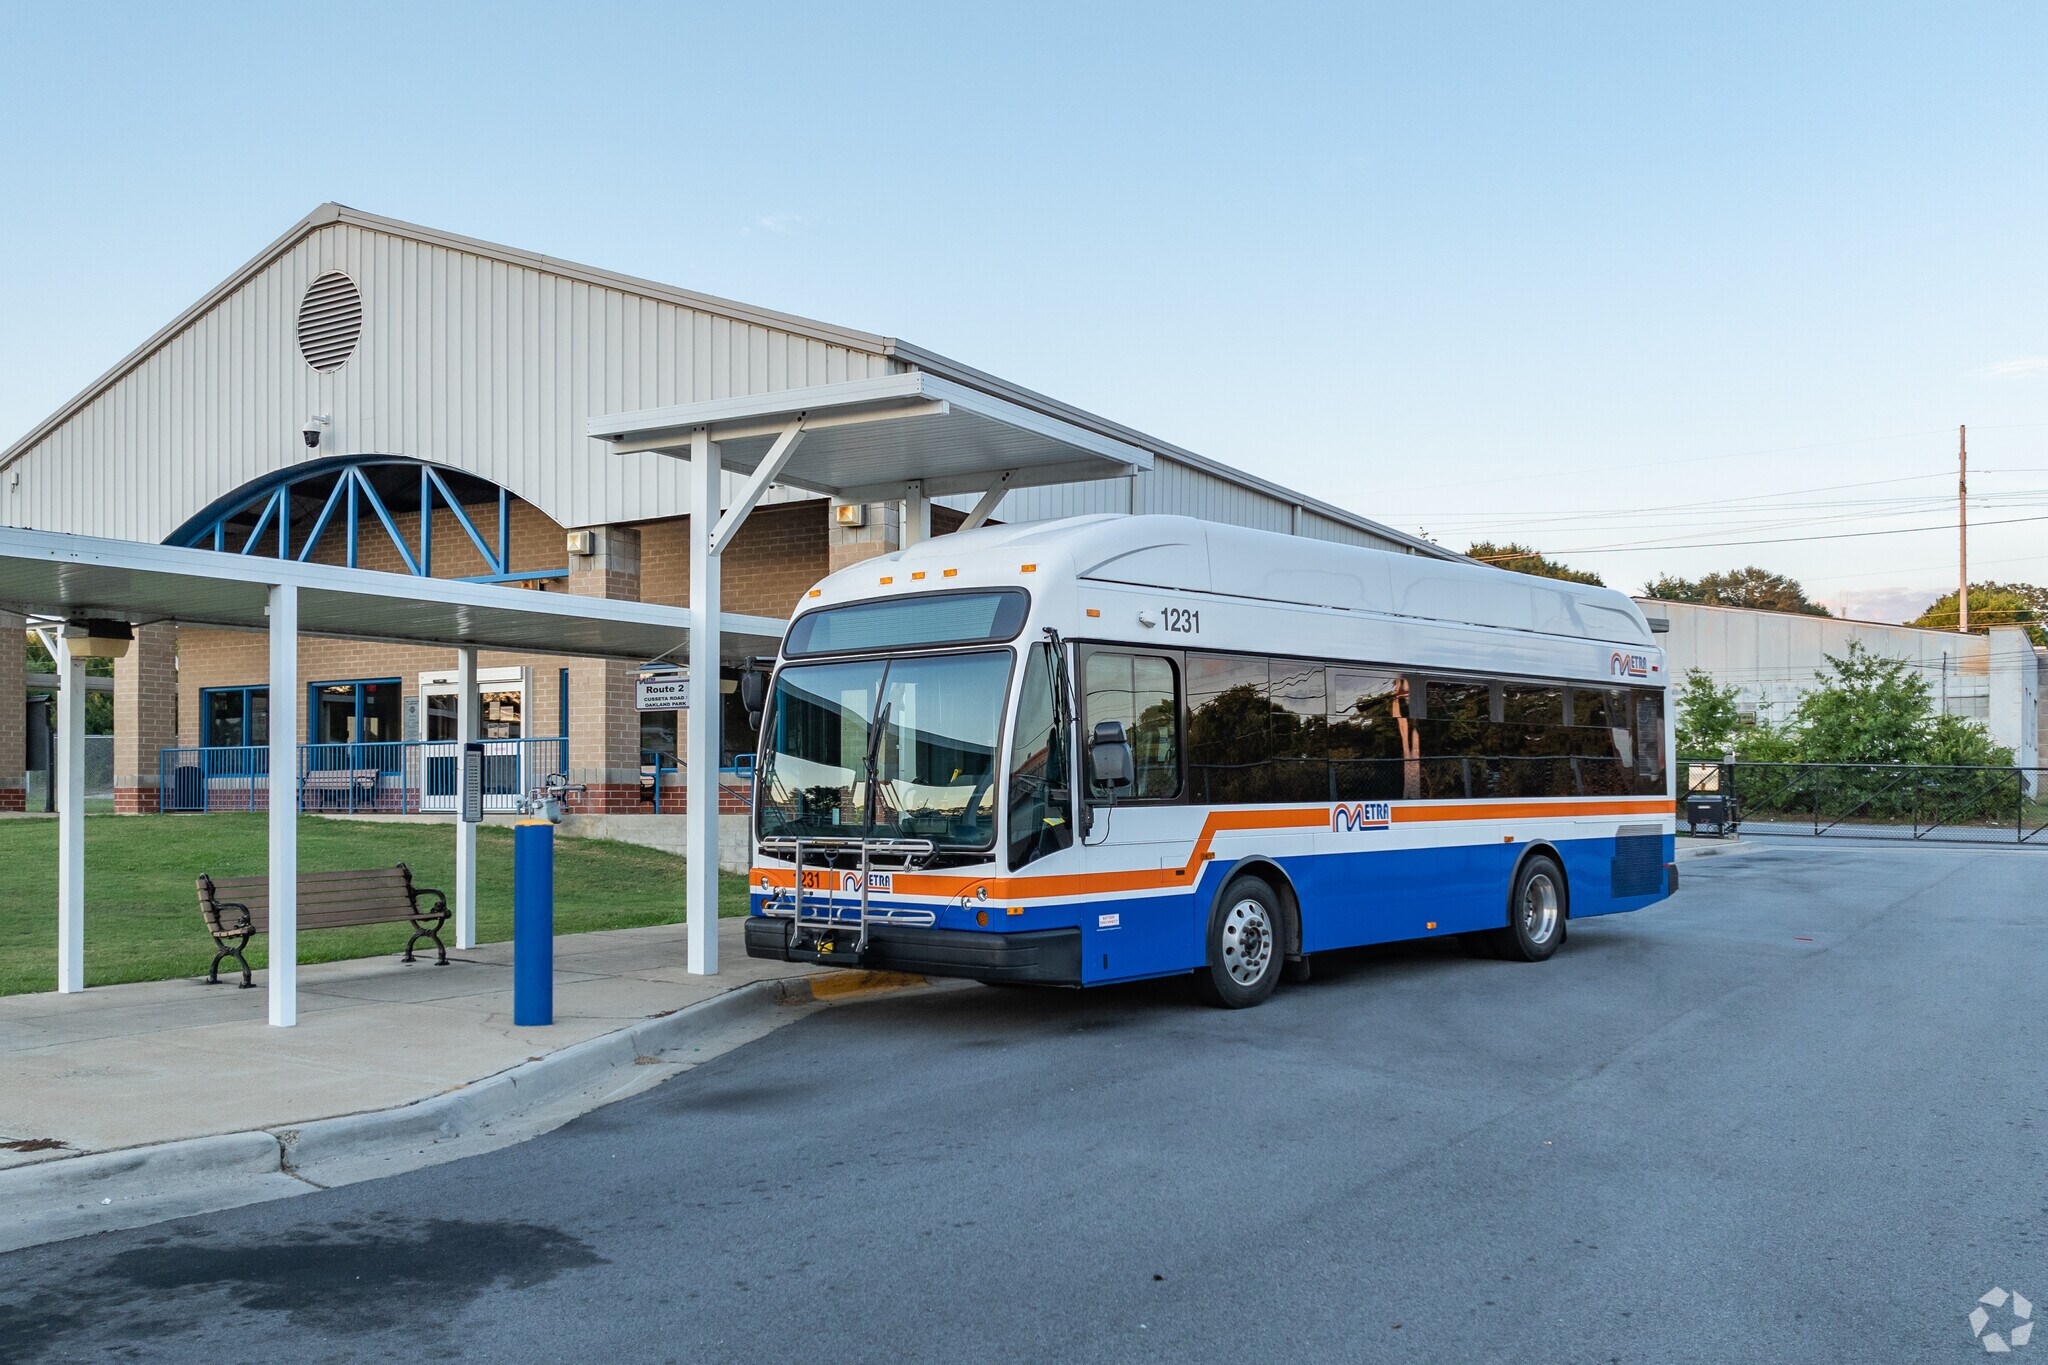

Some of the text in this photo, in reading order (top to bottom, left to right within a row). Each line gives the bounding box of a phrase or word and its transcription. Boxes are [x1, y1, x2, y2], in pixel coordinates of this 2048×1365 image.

[1160, 607, 1200, 634] 1231
[1611, 652, 1648, 678] METRA
[678, 684, 684, 692] 2
[1332, 803, 1389, 832] METRA
[793, 871, 820, 888] 231
[843, 871, 891, 894] METRA
